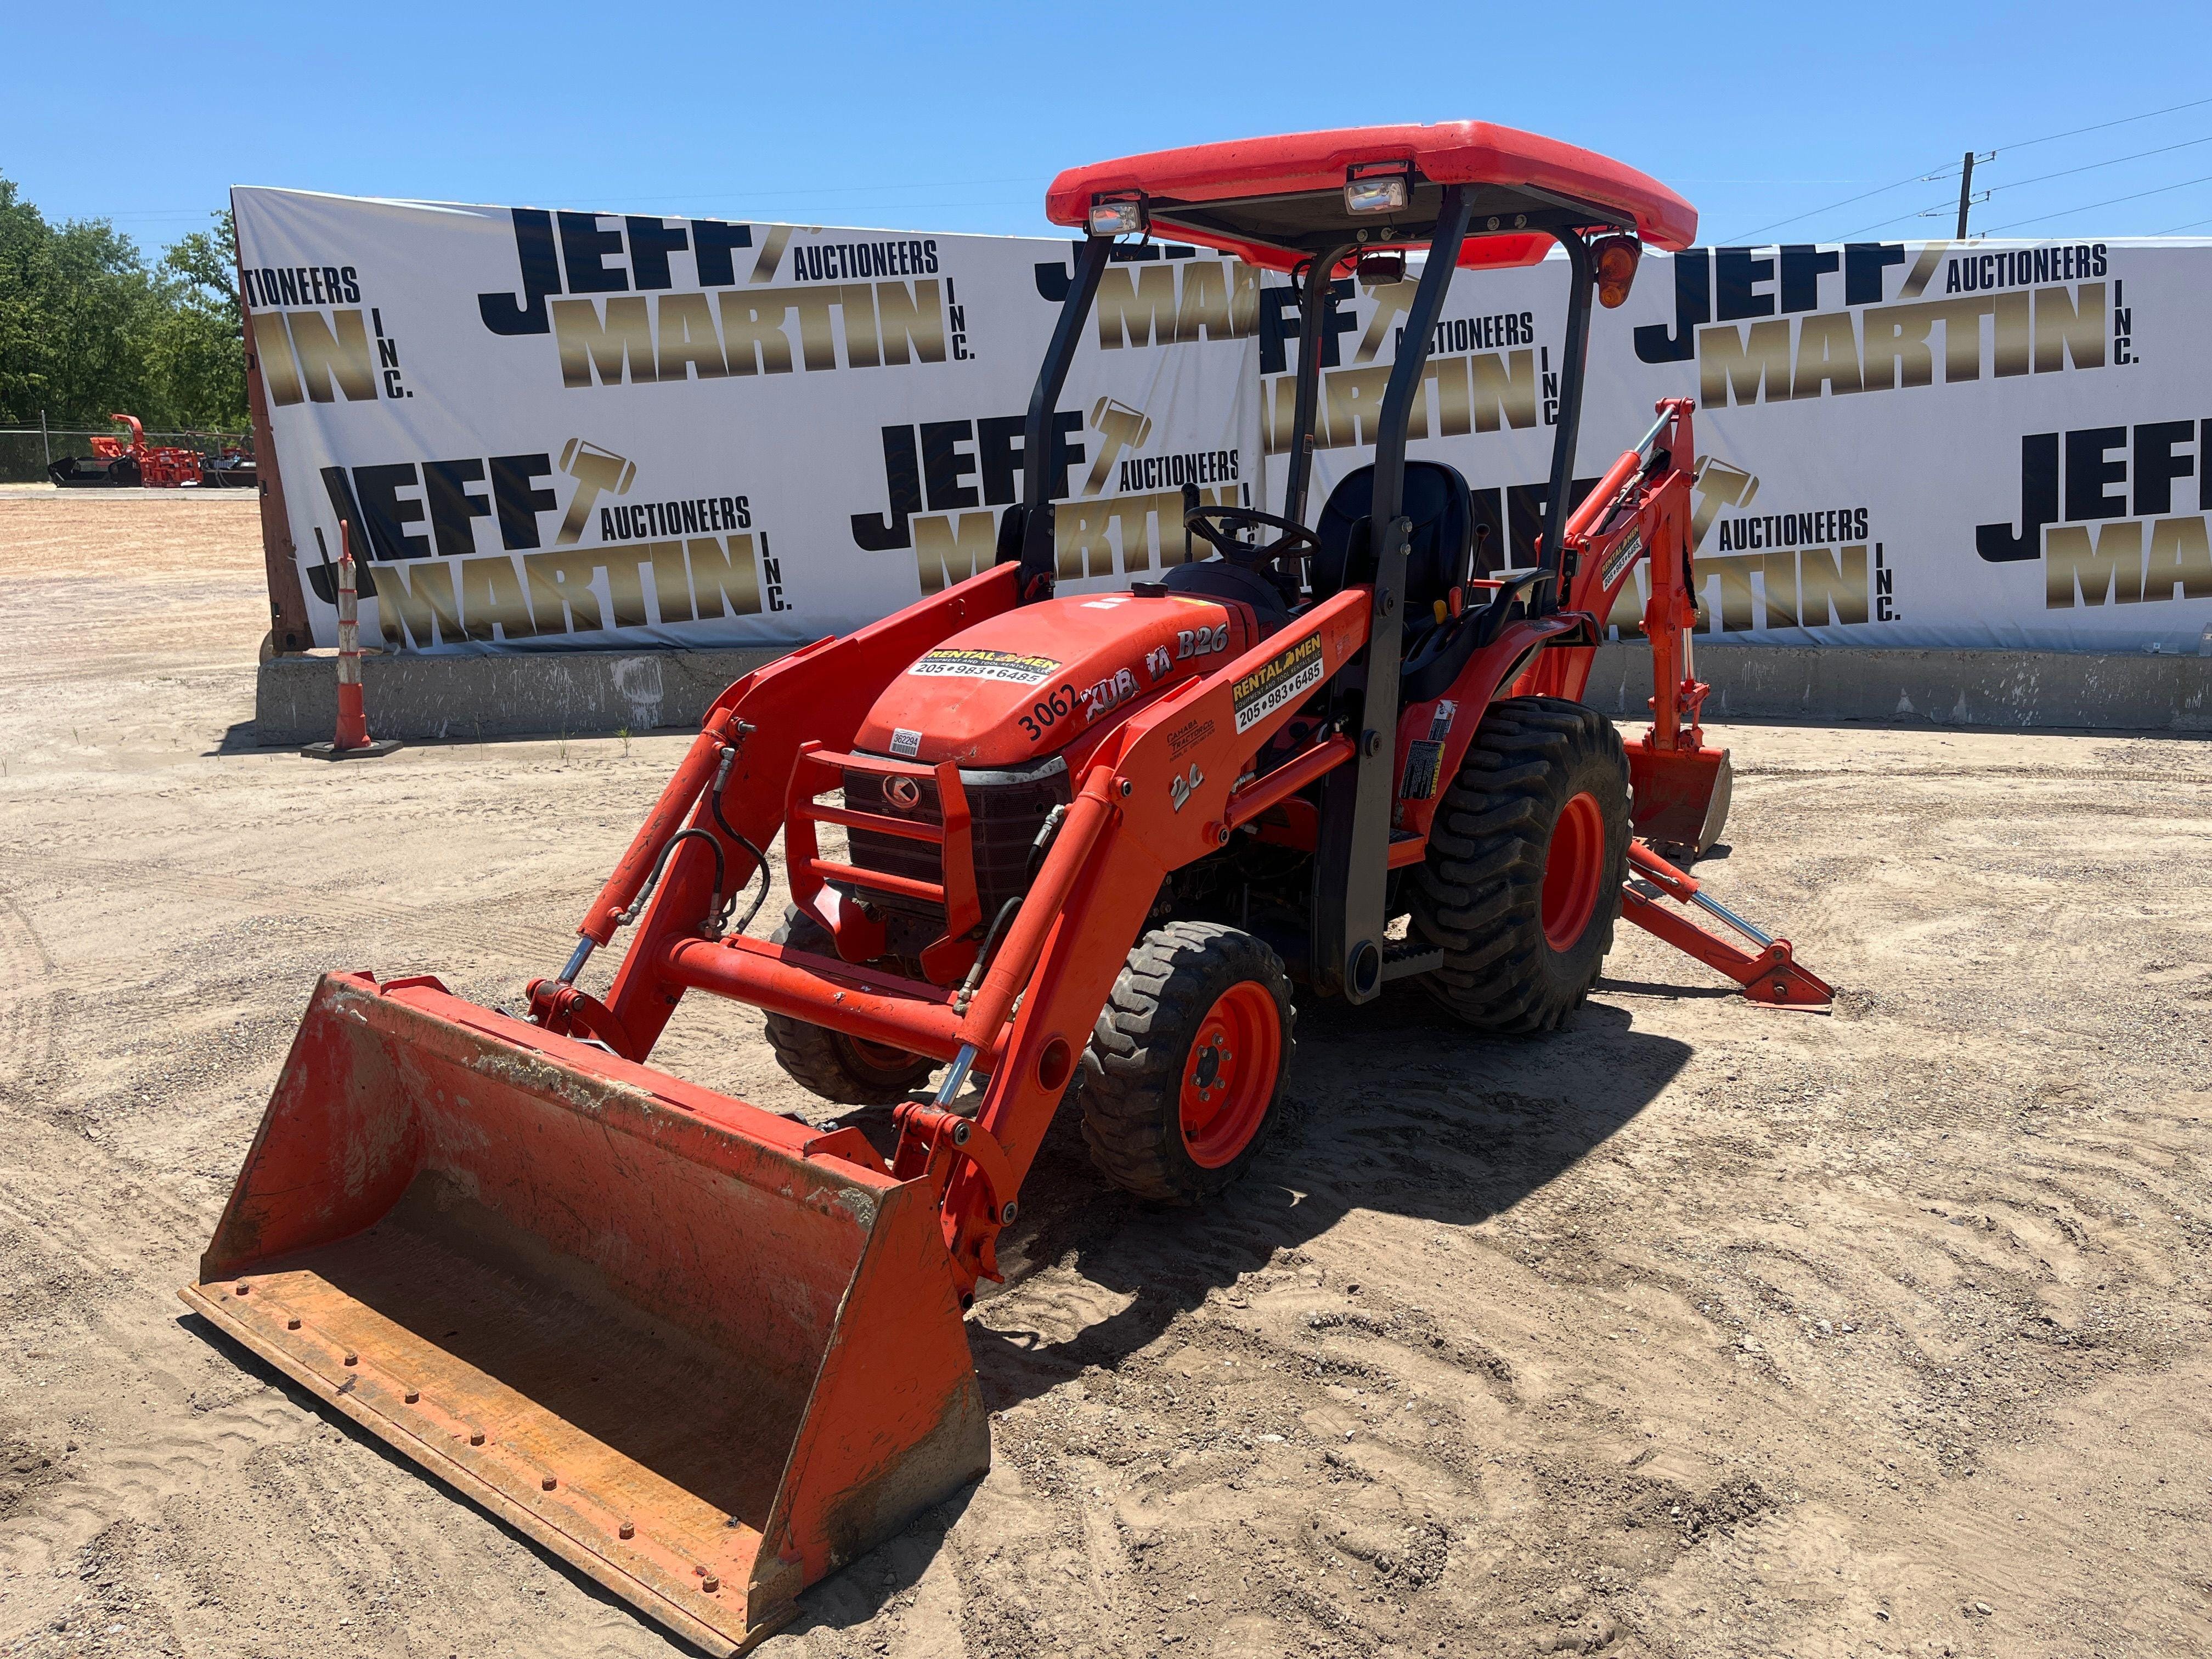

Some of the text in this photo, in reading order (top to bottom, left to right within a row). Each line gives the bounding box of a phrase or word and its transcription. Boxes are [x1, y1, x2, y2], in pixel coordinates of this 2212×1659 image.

[244, 267, 360, 308] TIONEERS
[478, 208, 752, 335] JEFF
[794, 240, 939, 281] AUCTIONEERS
[1946, 243, 2107, 294] AUCTIONEERS
[551, 279, 946, 388] MARTIN
[947, 277, 975, 360] INC.
[1634, 244, 1905, 364] JEFF
[2114, 279, 2139, 365] INC.
[251, 309, 378, 407] IN
[371, 308, 413, 399] INC.
[1699, 283, 2106, 409] MARTIN
[851, 410, 1086, 551] JEFF
[1120, 449, 1239, 492] AUCTIONEERS
[1976, 419, 2212, 562] JEF
[306, 453, 557, 605] JEFF
[601, 495, 752, 541] AUCTIONEERS
[1719, 507, 1868, 551] AUCTIONEERS
[370, 534, 763, 649] MARTIN
[760, 531, 792, 612] INC.
[1876, 543, 1901, 622] INC.
[927, 651, 1062, 670] RENTAL MEN
[1176, 621, 1228, 660] B26
[1233, 634, 1321, 702] RENTAL MEN
[1018, 684, 1082, 742] 3062
[1235, 689, 1263, 710] EQUIPMENT
[1265, 680, 1276, 691] AND
[1277, 673, 1290, 683] TOOL
[1313, 651, 1321, 659] LLC
[894, 734, 918, 746] 362294
[1167, 719, 1198, 743] CAHABA
[1172, 726, 1203, 752] TRACTOR
